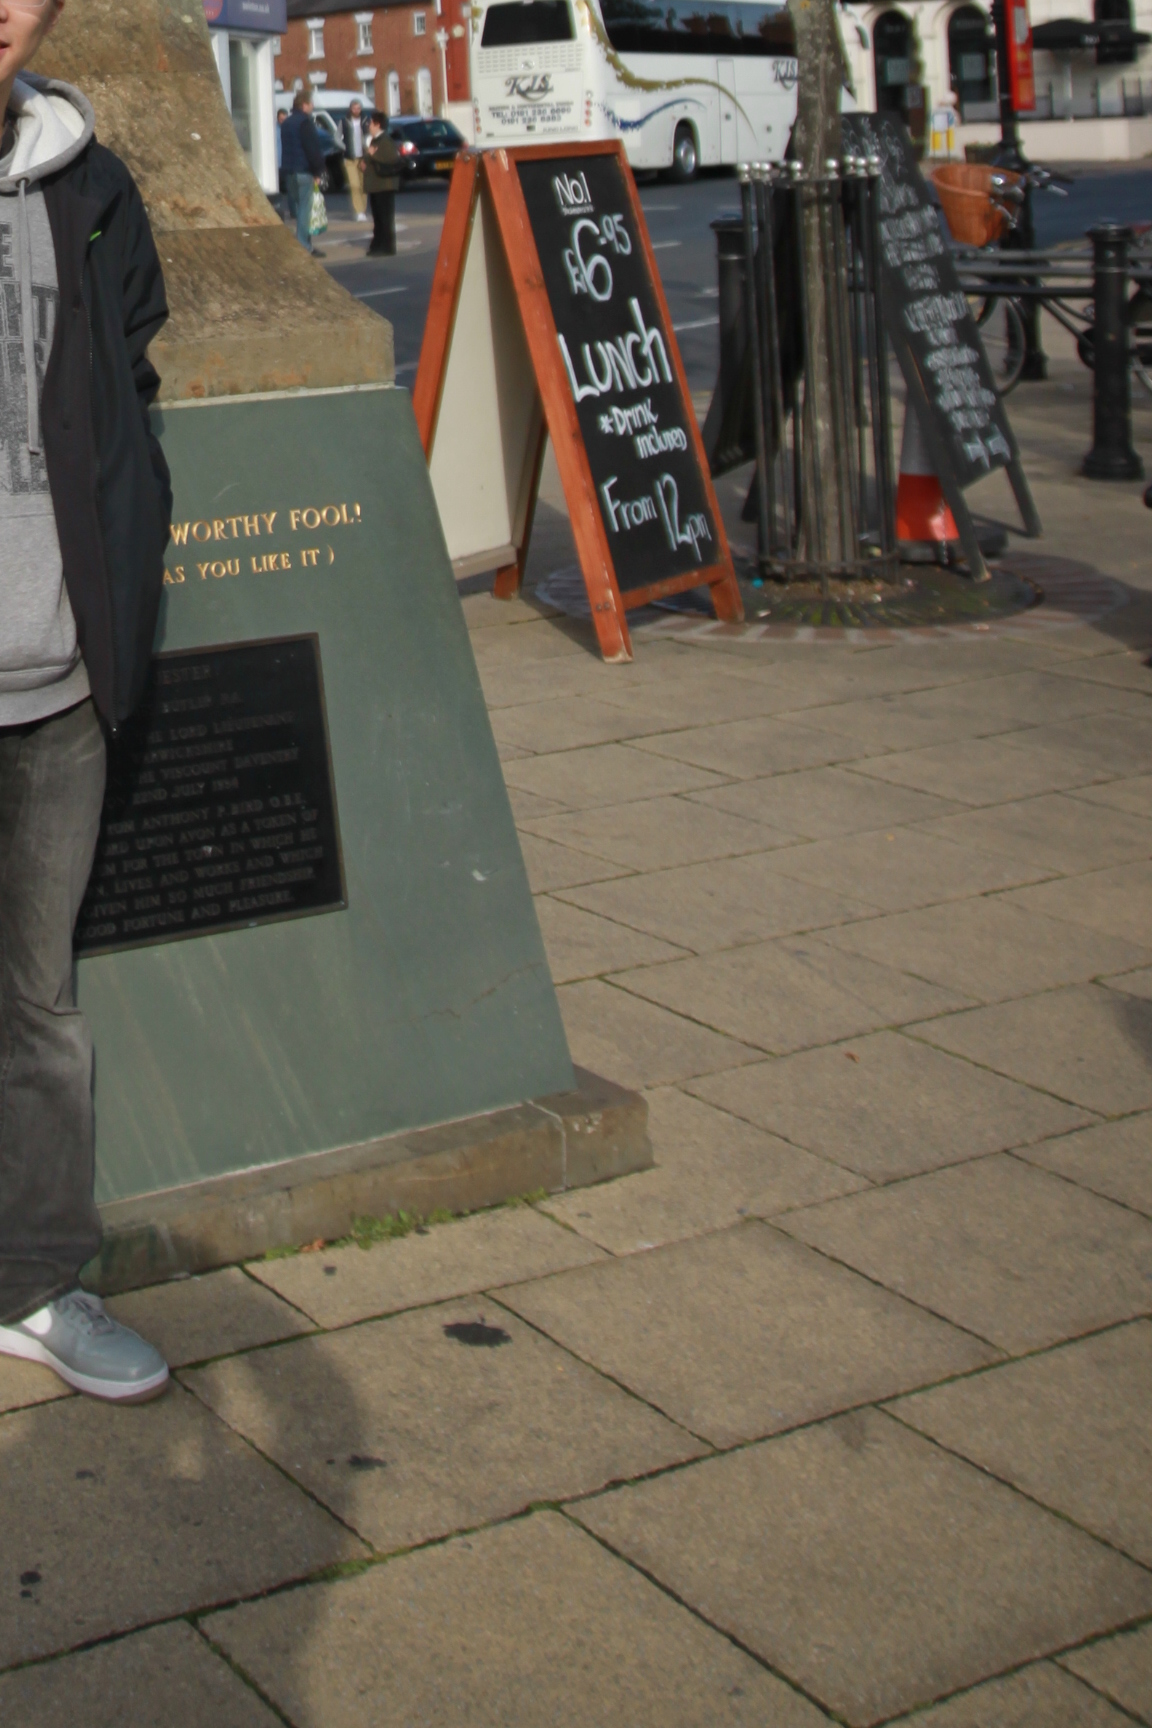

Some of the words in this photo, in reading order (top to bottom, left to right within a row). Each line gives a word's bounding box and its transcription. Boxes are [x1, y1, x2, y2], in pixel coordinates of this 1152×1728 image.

[555, 171, 592, 205] No.1
[603, 476, 658, 533] From
[169, 510, 278, 547] WORTHY
[289, 502, 362, 532] FOOL!
[196, 558, 241, 581] YOU
[251, 552, 292, 574] LIKE
[158, 664, 211, 685] ESTER
[160, 759, 227, 780] VISCOUNT
[141, 807, 210, 832] ANTHONY
[178, 827, 216, 845] AVON
[219, 822, 237, 838] AS
[251, 813, 297, 832] TOKEN
[122, 858, 148, 873] FOR
[152, 852, 180, 868] THE
[229, 841, 246, 855] IN
[114, 877, 154, 894] LIVES
[160, 870, 190, 888] AND
[245, 854, 275, 872] AND
[167, 889, 188, 905] SO
[122, 909, 186, 934] FORTUNE
[190, 903, 222, 921] AND
